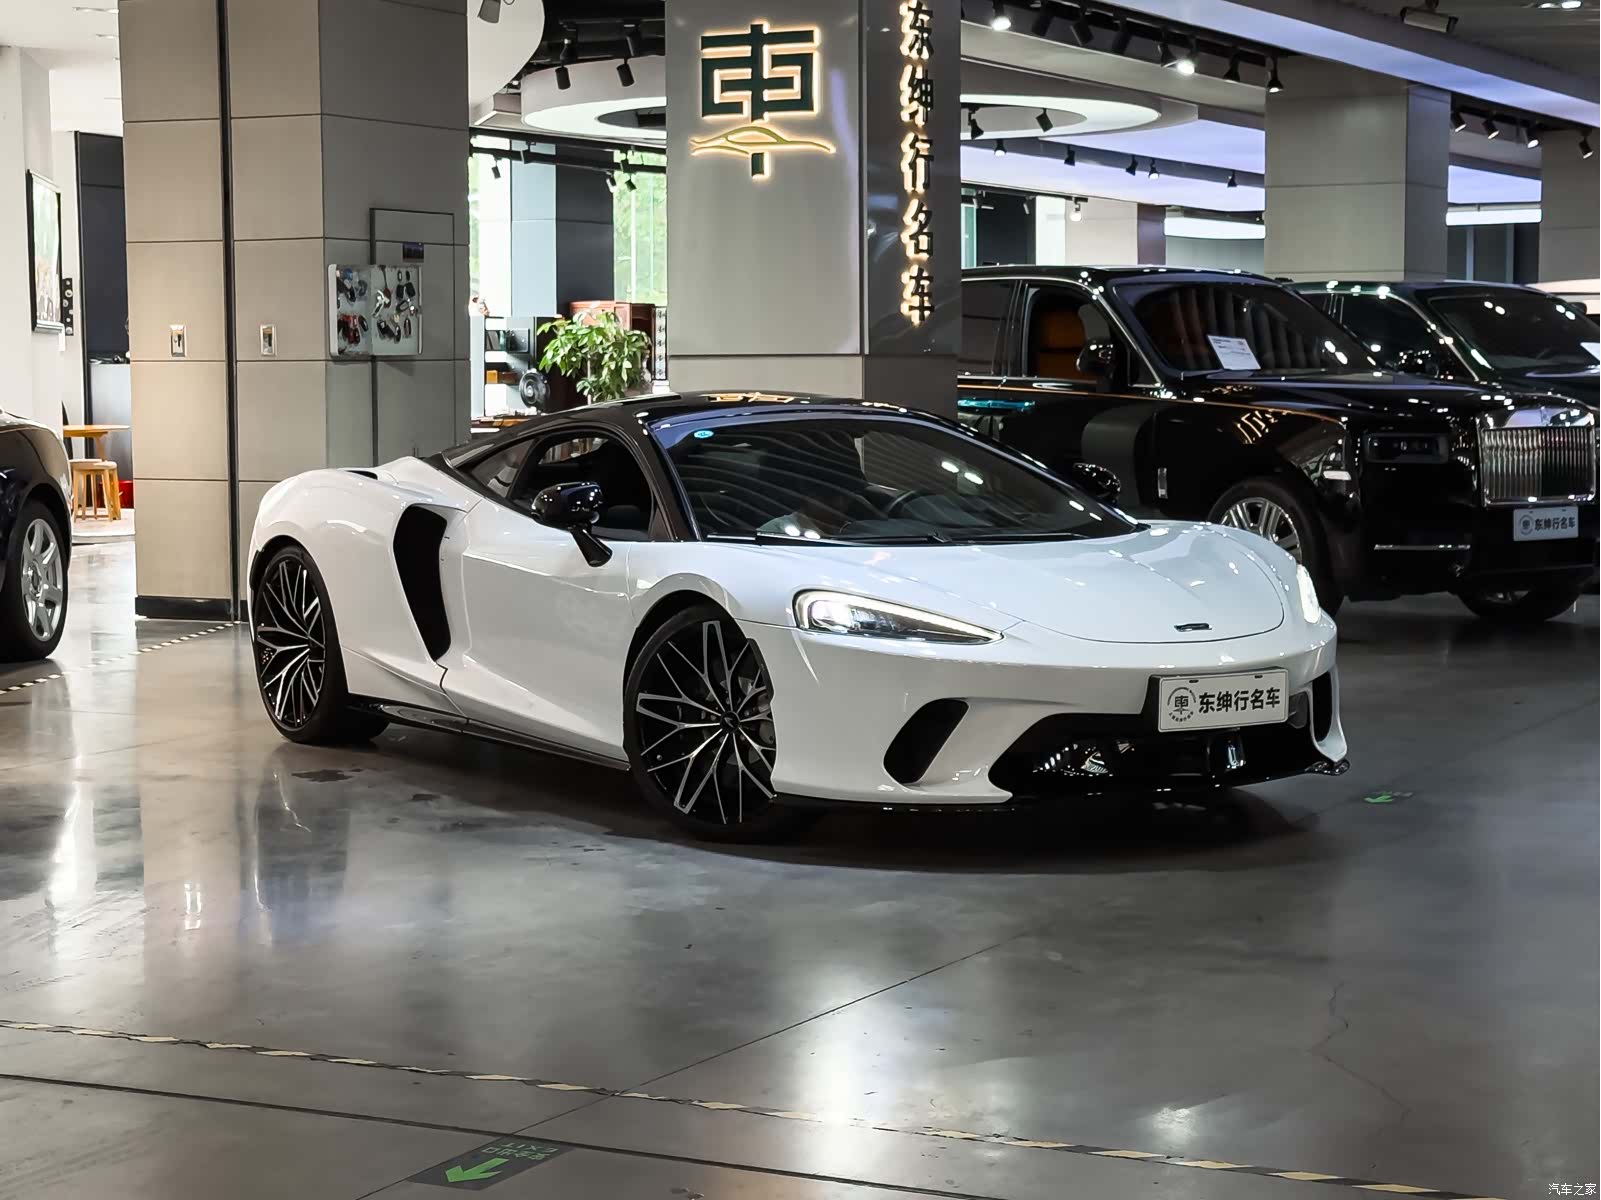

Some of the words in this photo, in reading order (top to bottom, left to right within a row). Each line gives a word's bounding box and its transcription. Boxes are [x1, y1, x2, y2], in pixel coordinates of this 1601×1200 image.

[901, 0, 934, 326] 东绅行名车
[1535, 516, 1576, 531] 东绅行名车
[1199, 687, 1280, 713] 东绅行名车
[501, 1142, 558, 1153] EXIT
